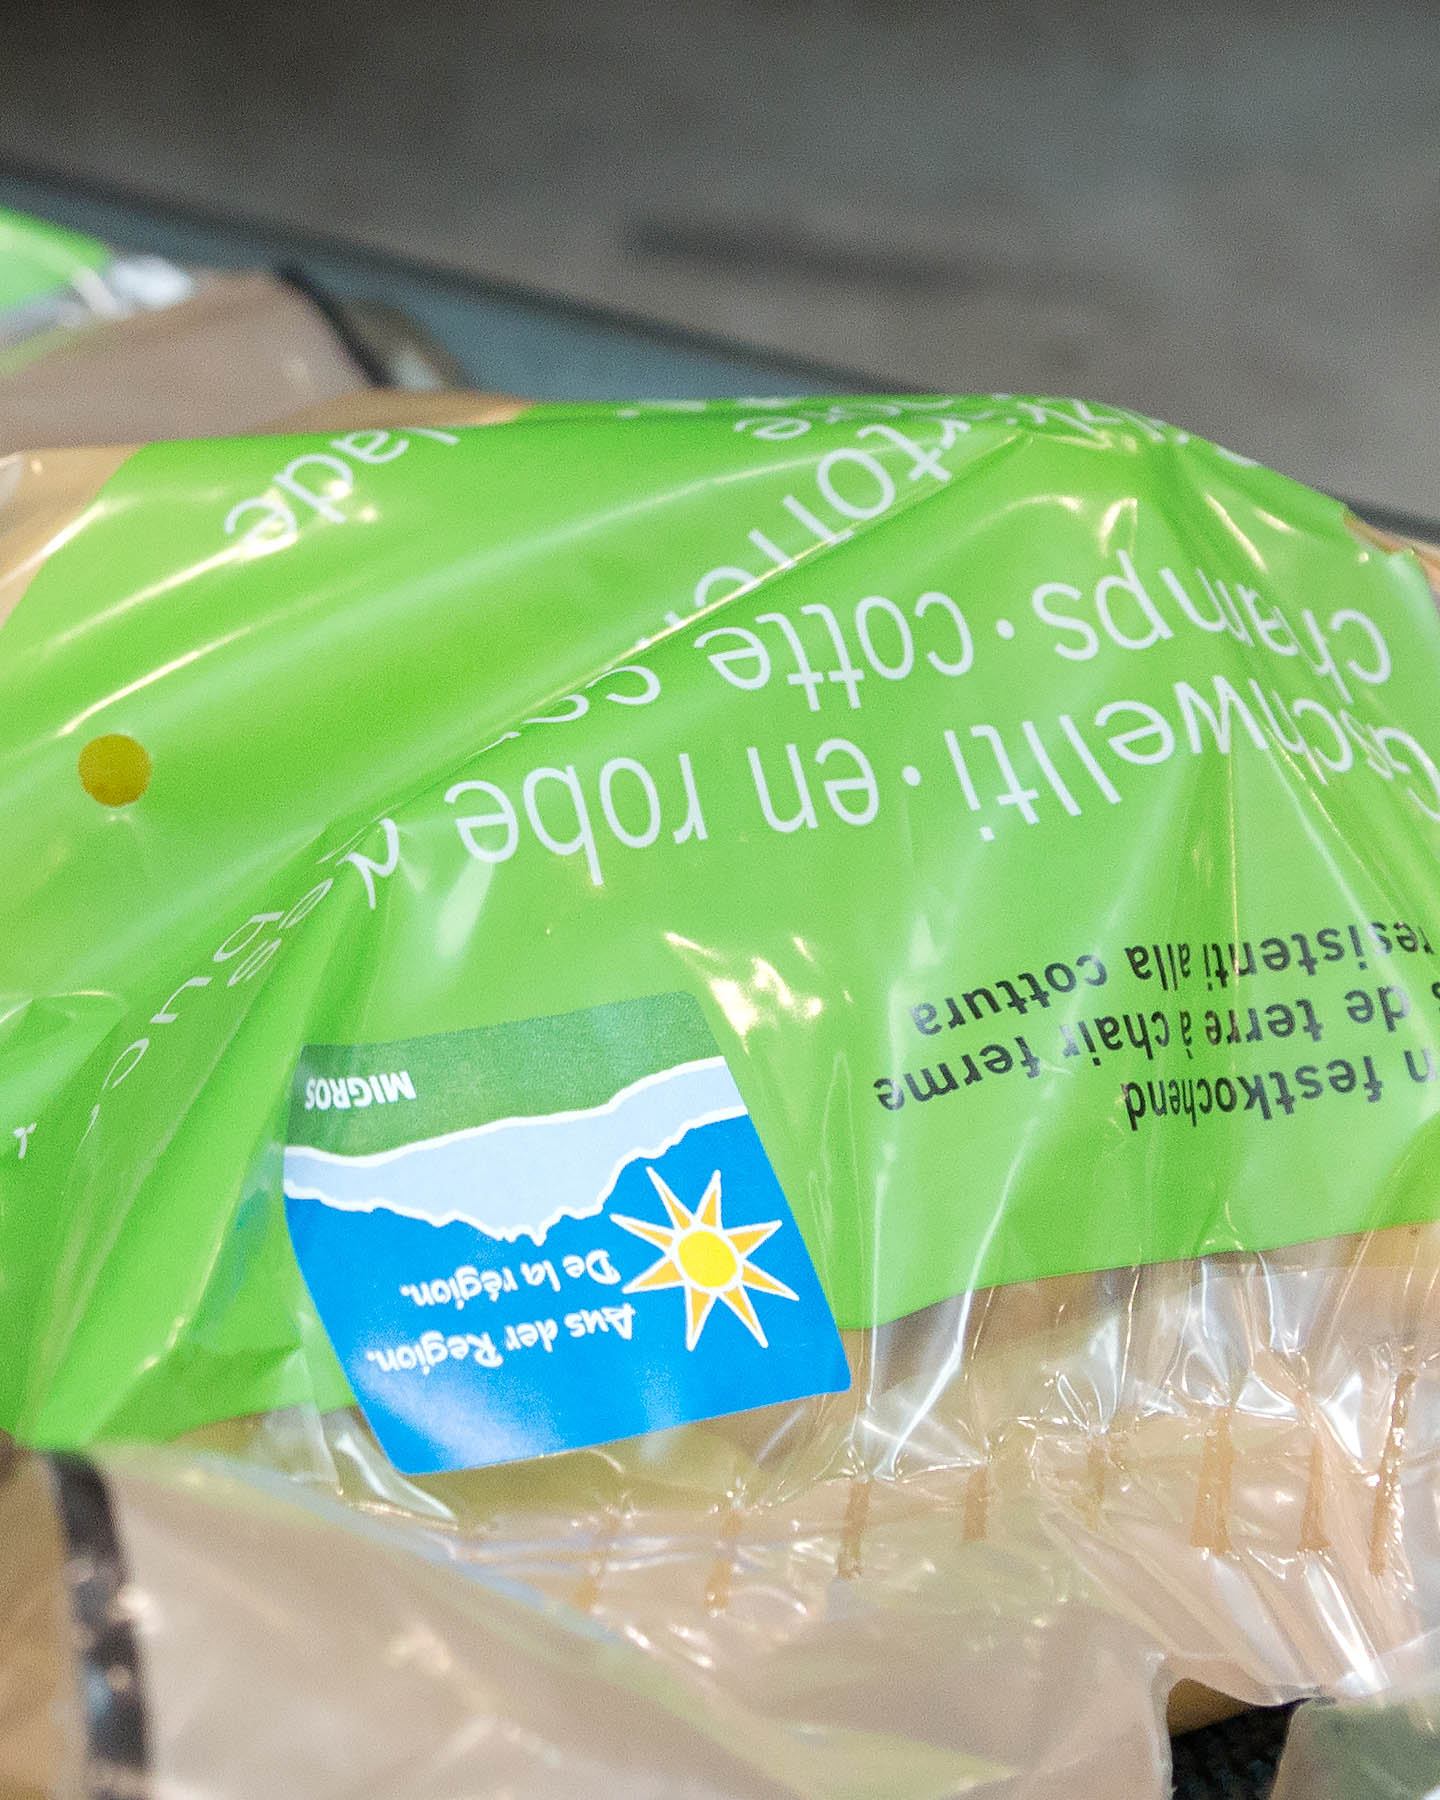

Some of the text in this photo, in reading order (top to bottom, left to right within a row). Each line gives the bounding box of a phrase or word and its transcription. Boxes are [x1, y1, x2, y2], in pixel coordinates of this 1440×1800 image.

[443, 752, 709, 886] robe
[1123, 941, 1192, 992] alla
[1202, 920, 1434, 991] resistenti
[908, 953, 1109, 1038] cottura
[1203, 998, 1324, 1047] terre
[1343, 985, 1411, 1033] de
[1059, 1010, 1170, 1067] chair
[1178, 1009, 1193, 1060] à
[303, 1070, 416, 1111] MIGROS
[872, 1035, 1041, 1112] ferme
[1119, 1055, 1384, 1132] festkochend
[399, 1249, 621, 1311] De la région.
[365, 1302, 636, 1376] Aus der Region.
